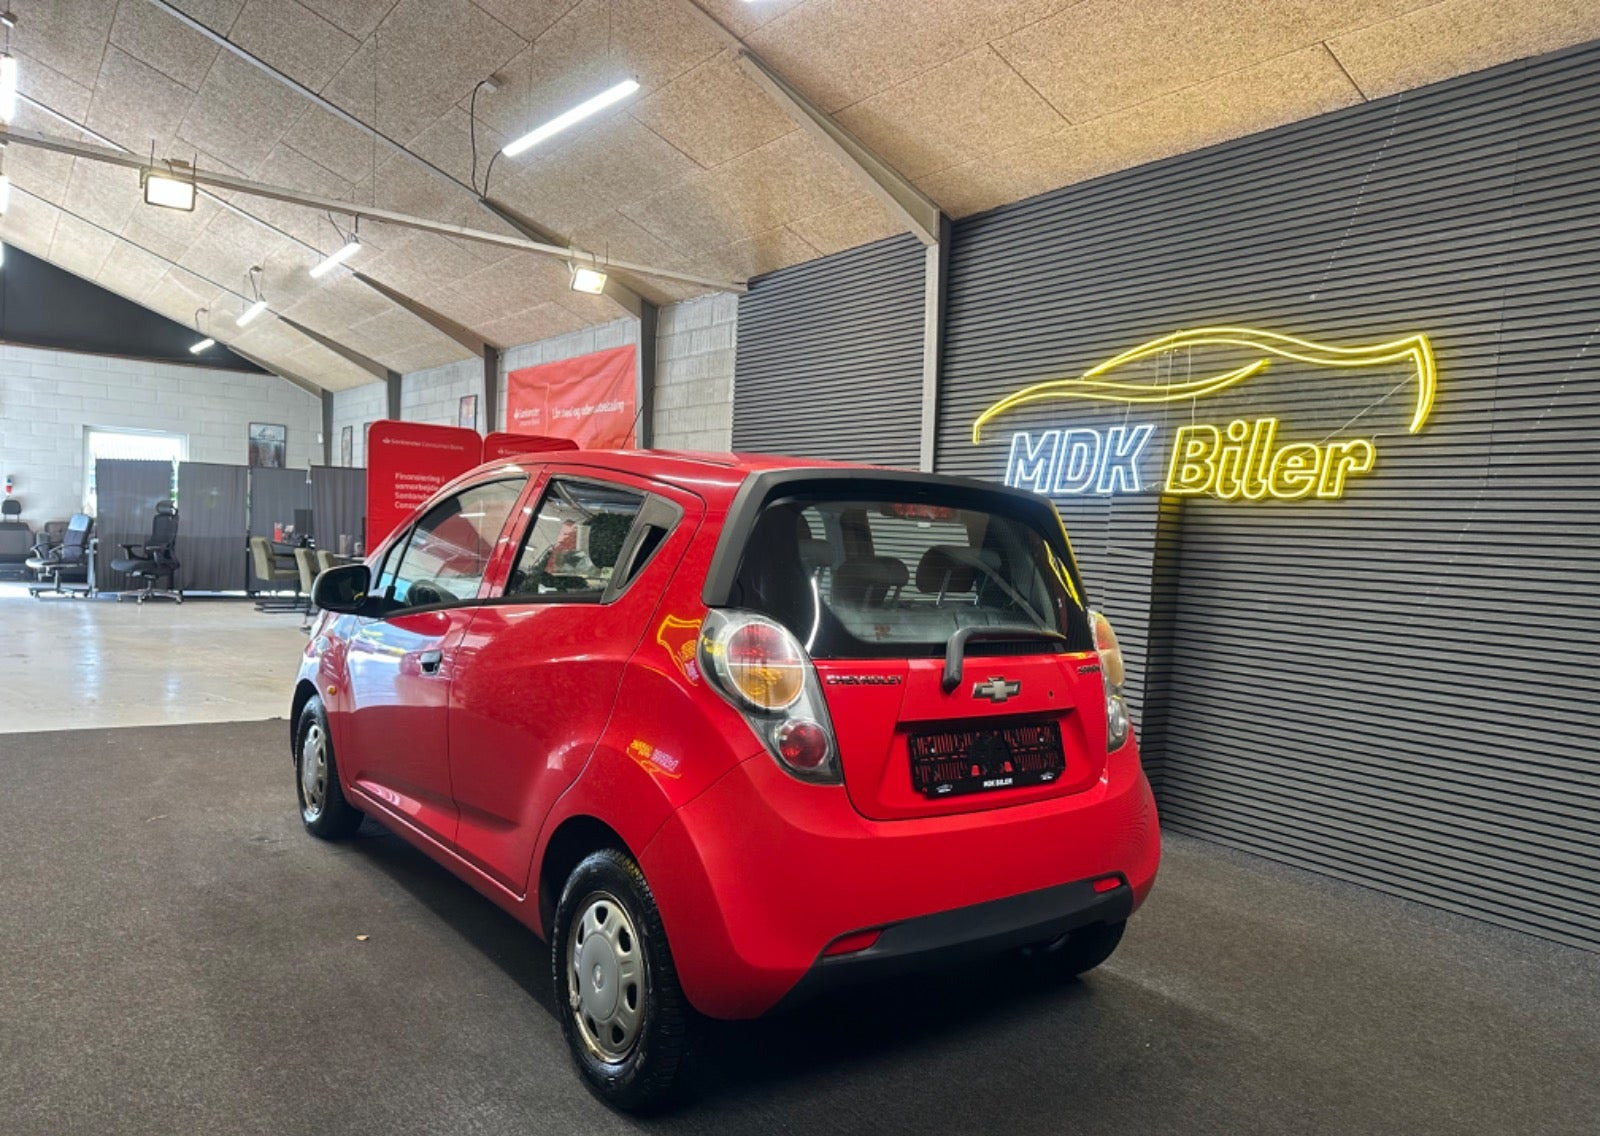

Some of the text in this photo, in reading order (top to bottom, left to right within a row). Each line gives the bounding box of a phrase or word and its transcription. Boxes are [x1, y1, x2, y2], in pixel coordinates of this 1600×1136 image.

[391, 438, 421, 447] Santander
[1004, 416, 1377, 500] MDK Biler
[395, 472, 440, 484] Finansiering
[395, 491, 430, 500] Santande
[826, 674, 903, 685] CHEVROLET
[996, 777, 1014, 786] BILER
